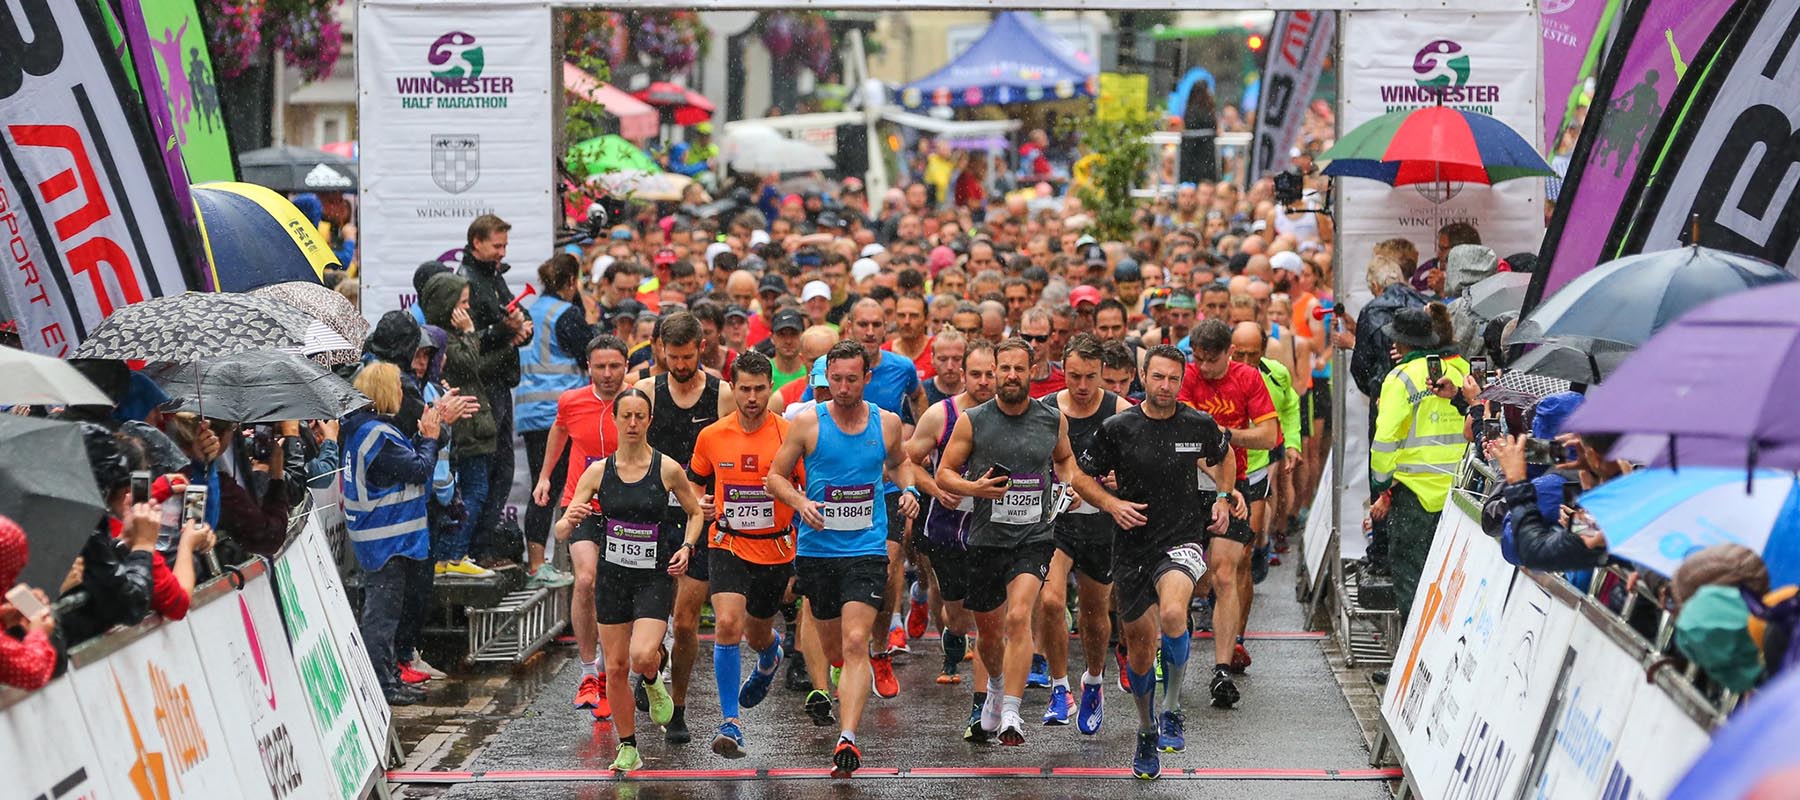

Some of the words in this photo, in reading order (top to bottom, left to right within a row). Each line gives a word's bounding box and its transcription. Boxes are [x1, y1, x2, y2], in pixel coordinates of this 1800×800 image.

[396, 76, 514, 94] WINCHESTER
[1380, 85, 1500, 103] WINCHESTER
[402, 97, 433, 108] HALF
[437, 97, 507, 108] MARATHON
[416, 208, 495, 218] WINCHESTER
[1005, 494, 1031, 506] 1325
[737, 506, 759, 518] 275
[836, 506, 863, 518] 1884
[621, 544, 641, 556] 153
